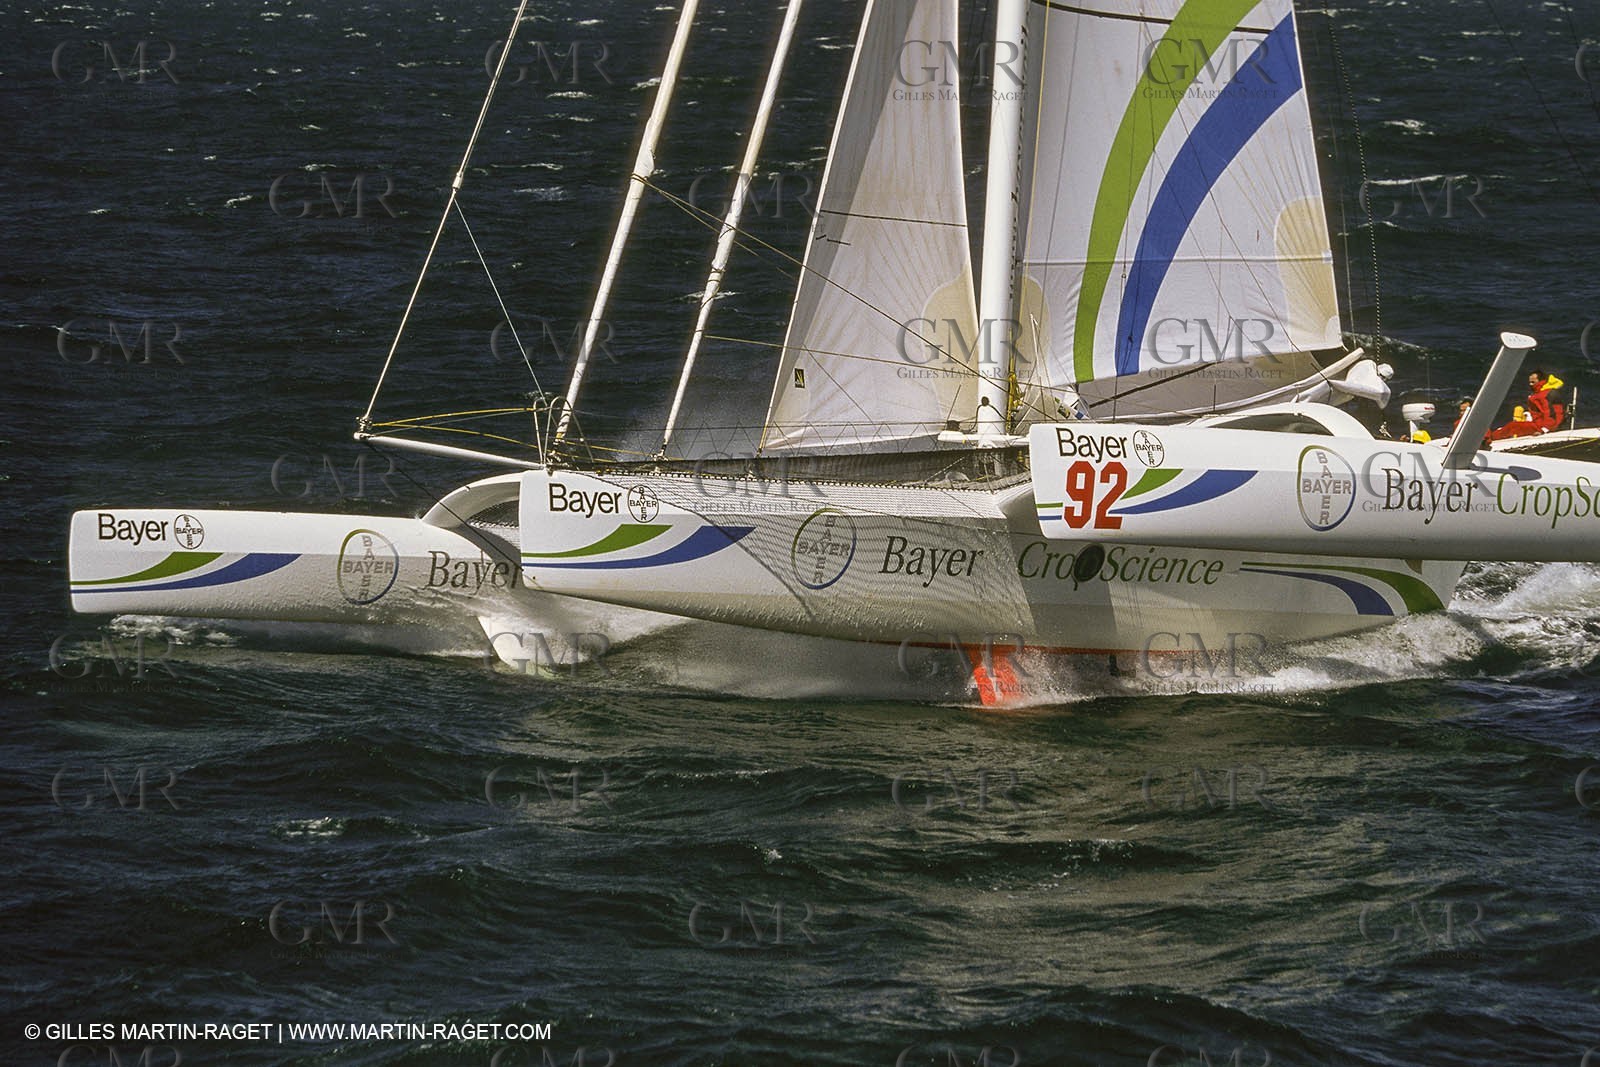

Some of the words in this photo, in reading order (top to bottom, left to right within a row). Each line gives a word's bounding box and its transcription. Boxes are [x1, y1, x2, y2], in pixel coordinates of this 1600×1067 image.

[1055, 427, 1129, 463] Bayer
[549, 483, 622, 519] Bayer
[1063, 460, 1129, 530] 92
[1302, 479, 1352, 495] BAYER
[1381, 468, 1478, 525] Bayer
[98, 513, 168, 545] Bayer
[797, 541, 850, 556] BAYER
[878, 535, 984, 588] Bayer
[343, 561, 394, 574] BAYER
